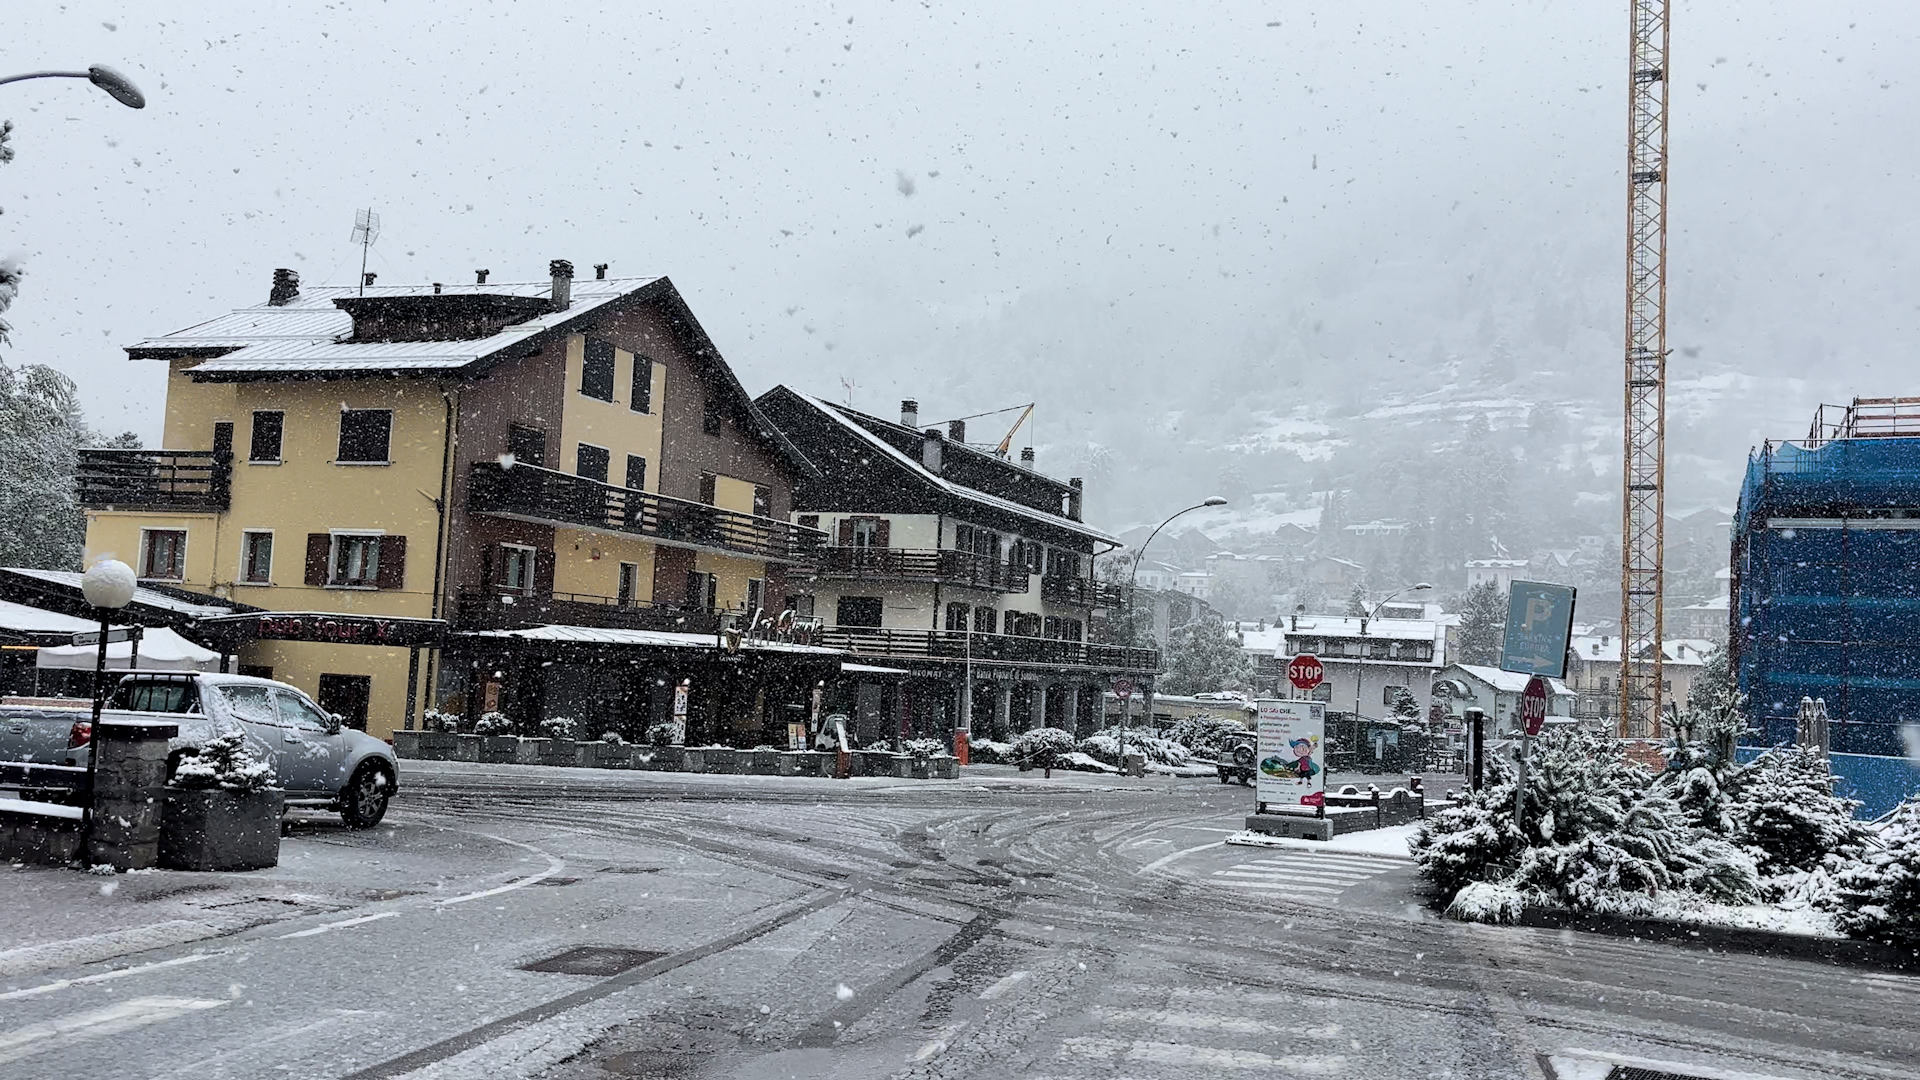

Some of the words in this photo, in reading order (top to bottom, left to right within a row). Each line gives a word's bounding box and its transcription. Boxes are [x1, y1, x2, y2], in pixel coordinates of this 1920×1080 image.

[1523, 598, 1552, 631] P
[259, 616, 302, 637] pub
[374, 619, 390, 639] X
[1290, 665, 1322, 679] STOP
[1524, 695, 1545, 719] STOP
